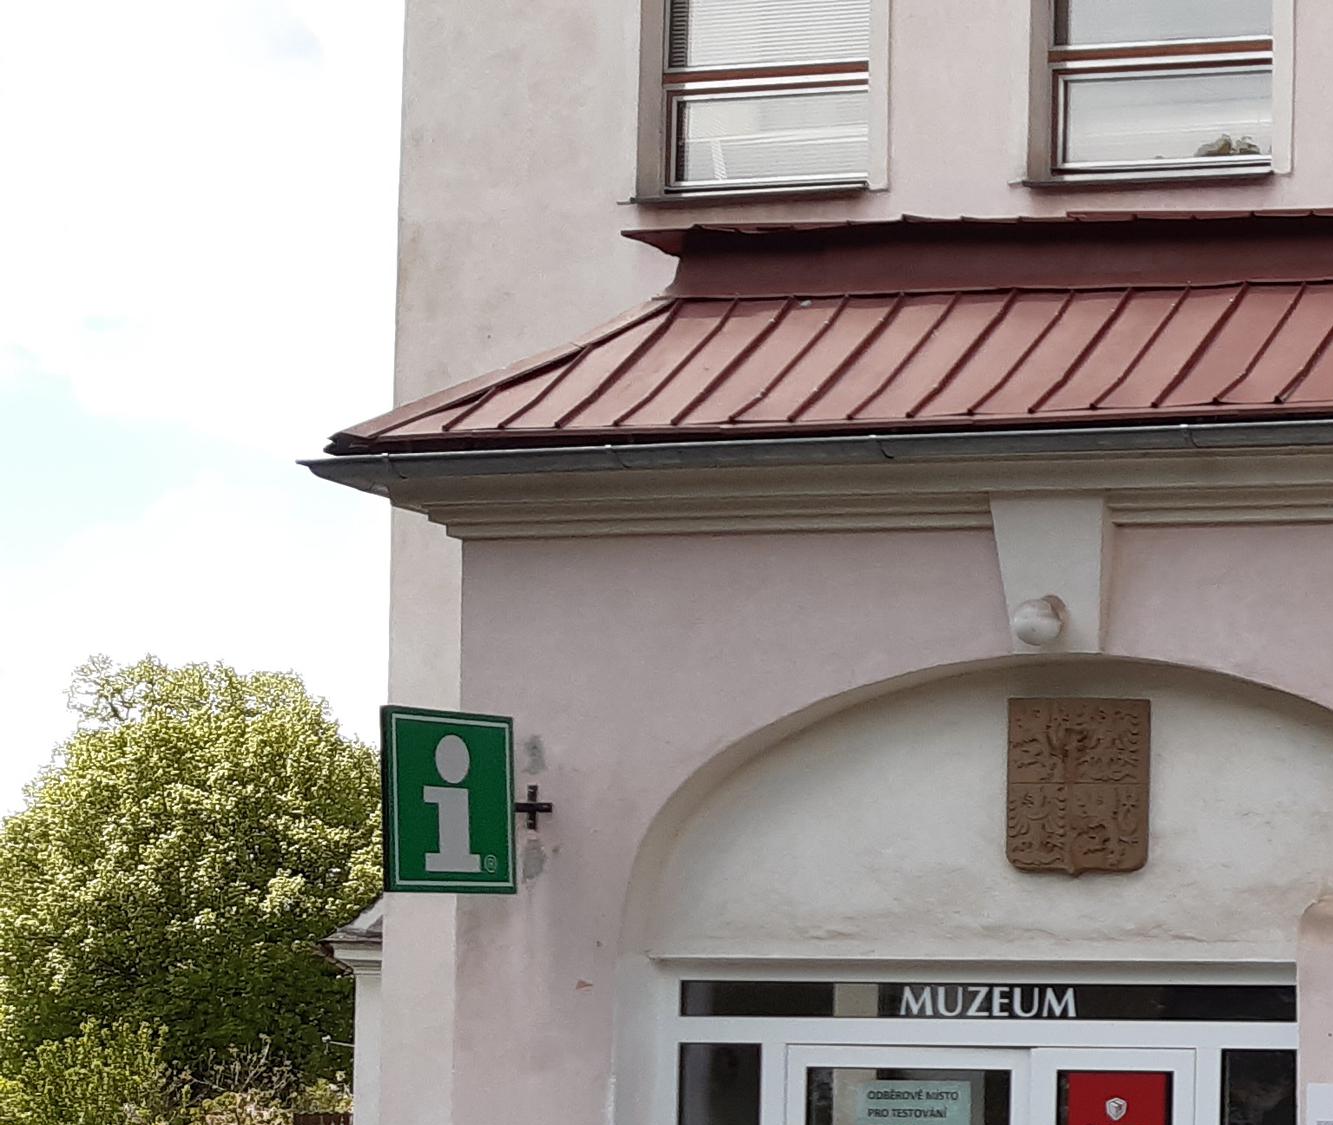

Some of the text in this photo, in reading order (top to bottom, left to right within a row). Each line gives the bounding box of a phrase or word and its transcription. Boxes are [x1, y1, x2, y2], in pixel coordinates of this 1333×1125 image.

[900, 985, 1078, 1018] MUZEUM
[866, 1089, 959, 1101] ODBĚROVÉ MÍSTO
[867, 1105, 948, 1118] PRO TESTOVÁNÍ
